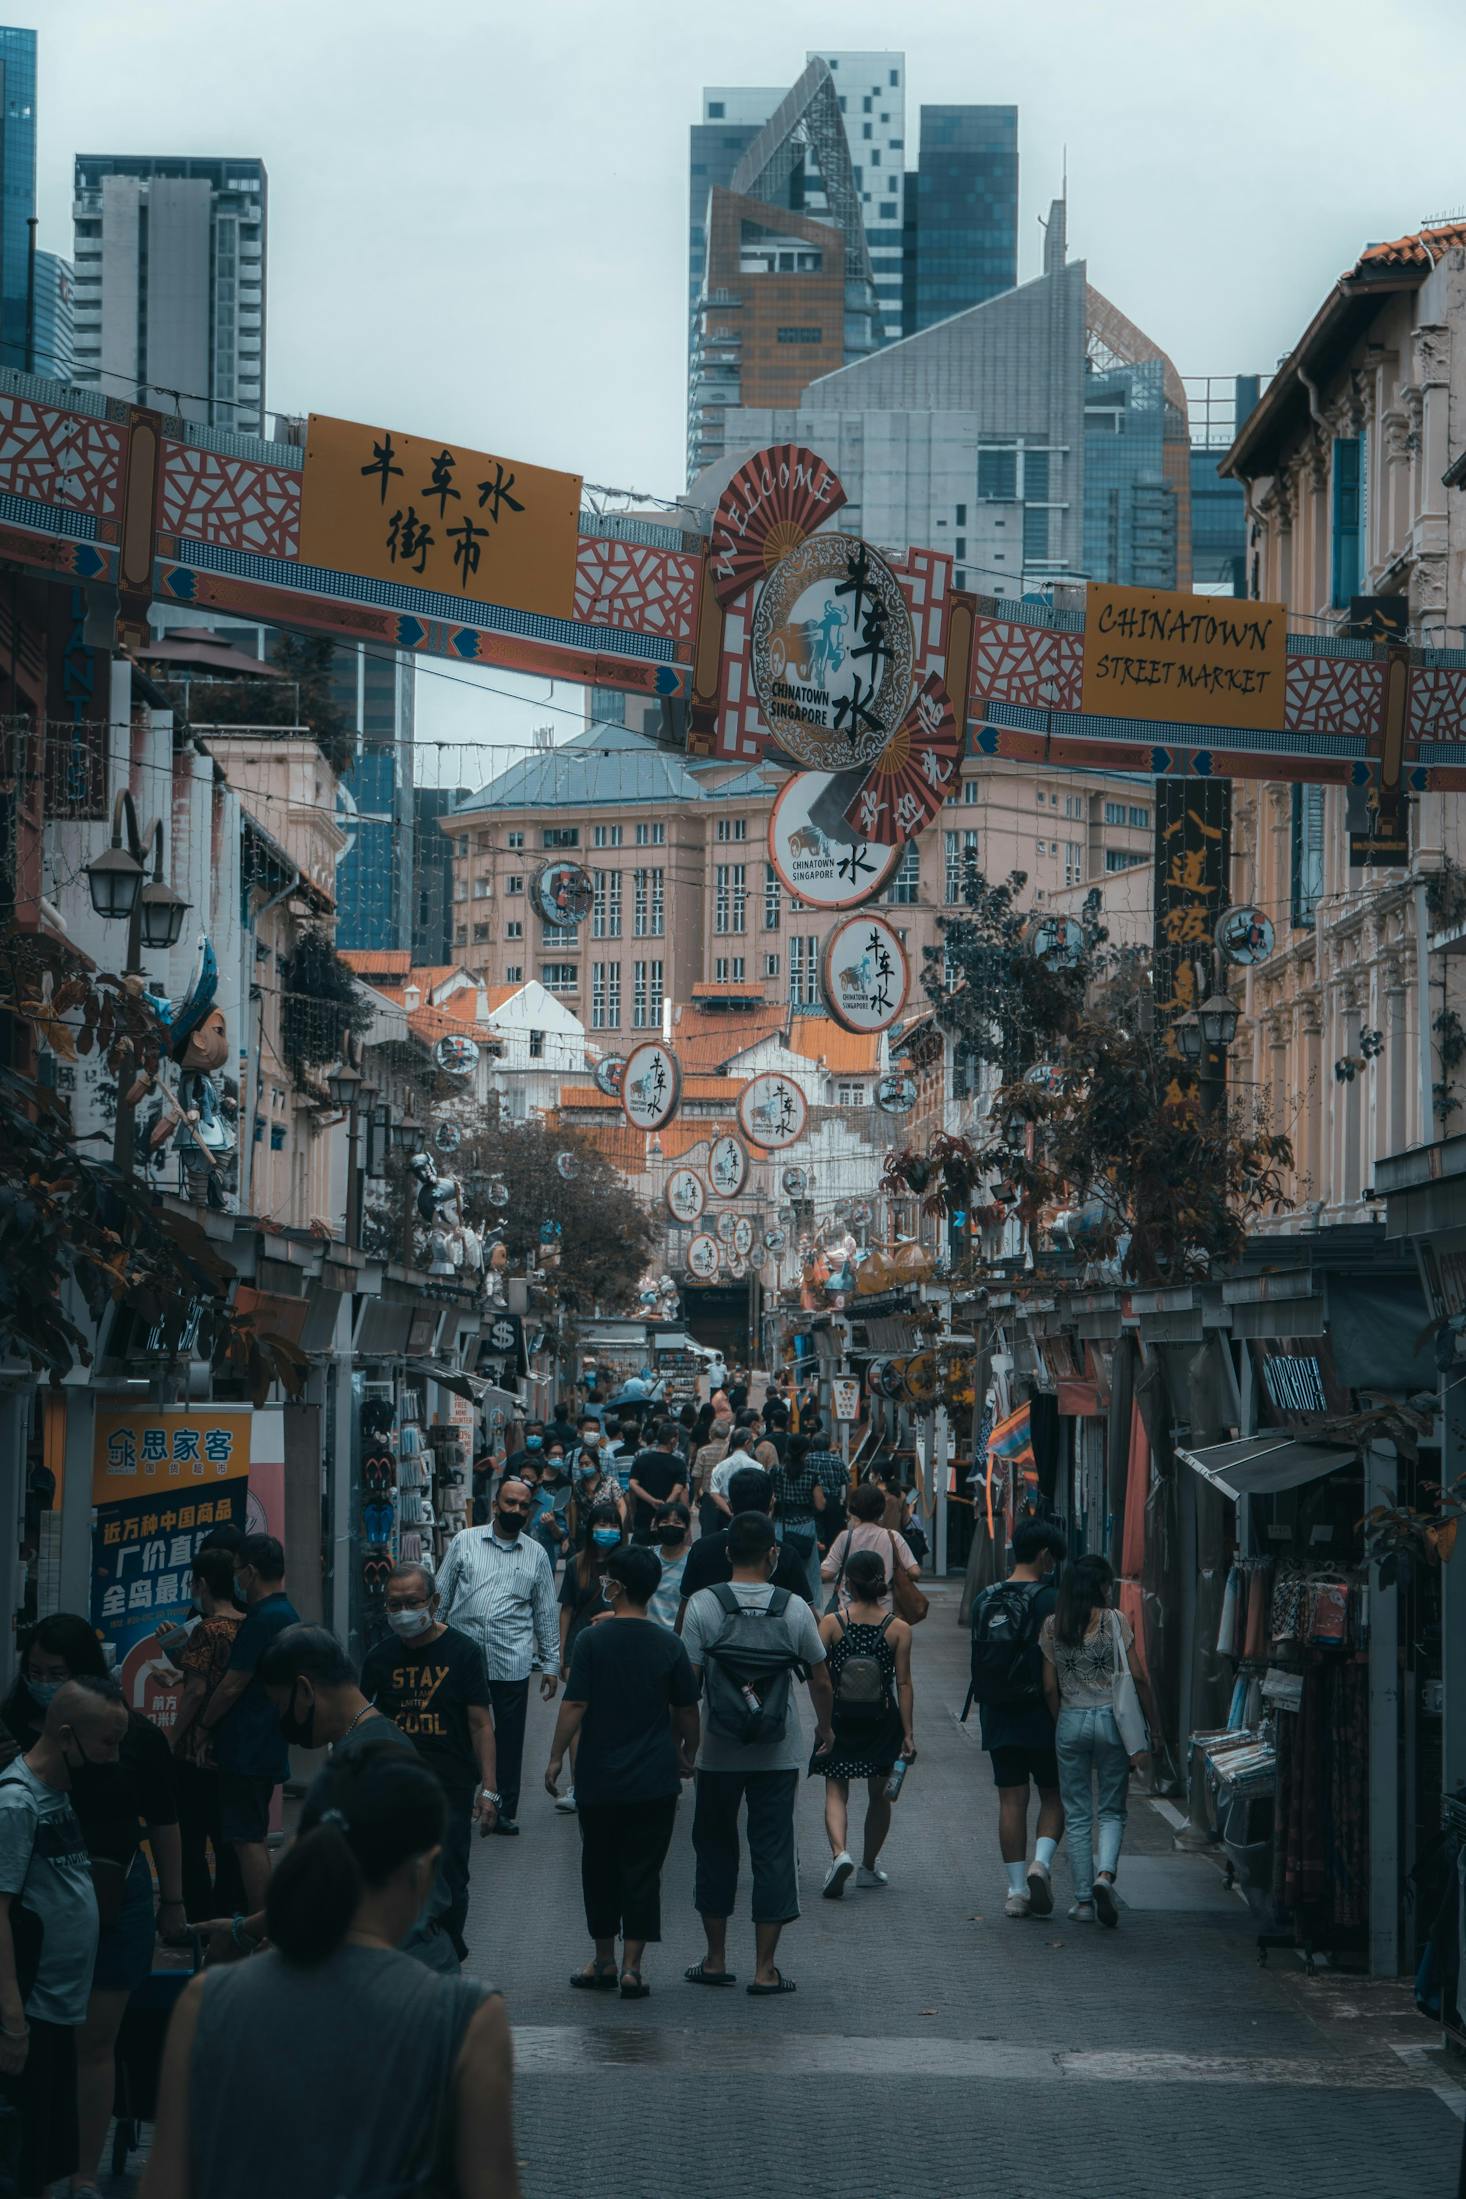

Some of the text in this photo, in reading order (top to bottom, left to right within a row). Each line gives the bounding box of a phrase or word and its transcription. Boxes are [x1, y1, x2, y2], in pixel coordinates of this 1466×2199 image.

[360, 432, 525, 522] 牛车水
[716, 462, 836, 580] WELCOME
[386, 506, 491, 588] 街市
[1098, 602, 1273, 651] CHINATOWN
[1095, 653, 1271, 695] STREET MARKET
[771, 681, 830, 707] CHINATOWN
[770, 701, 828, 726] SINGAPORE
[792, 858, 835, 871] CHINATOWN
[792, 869, 834, 882] SINGAPORE
[491, 1320, 515, 1350] $
[140, 1428, 233, 1462] 思家客
[103, 1497, 233, 1546] 近万种中国商品
[391, 1664, 450, 1702] STAY
[394, 1711, 448, 1736] COOL
